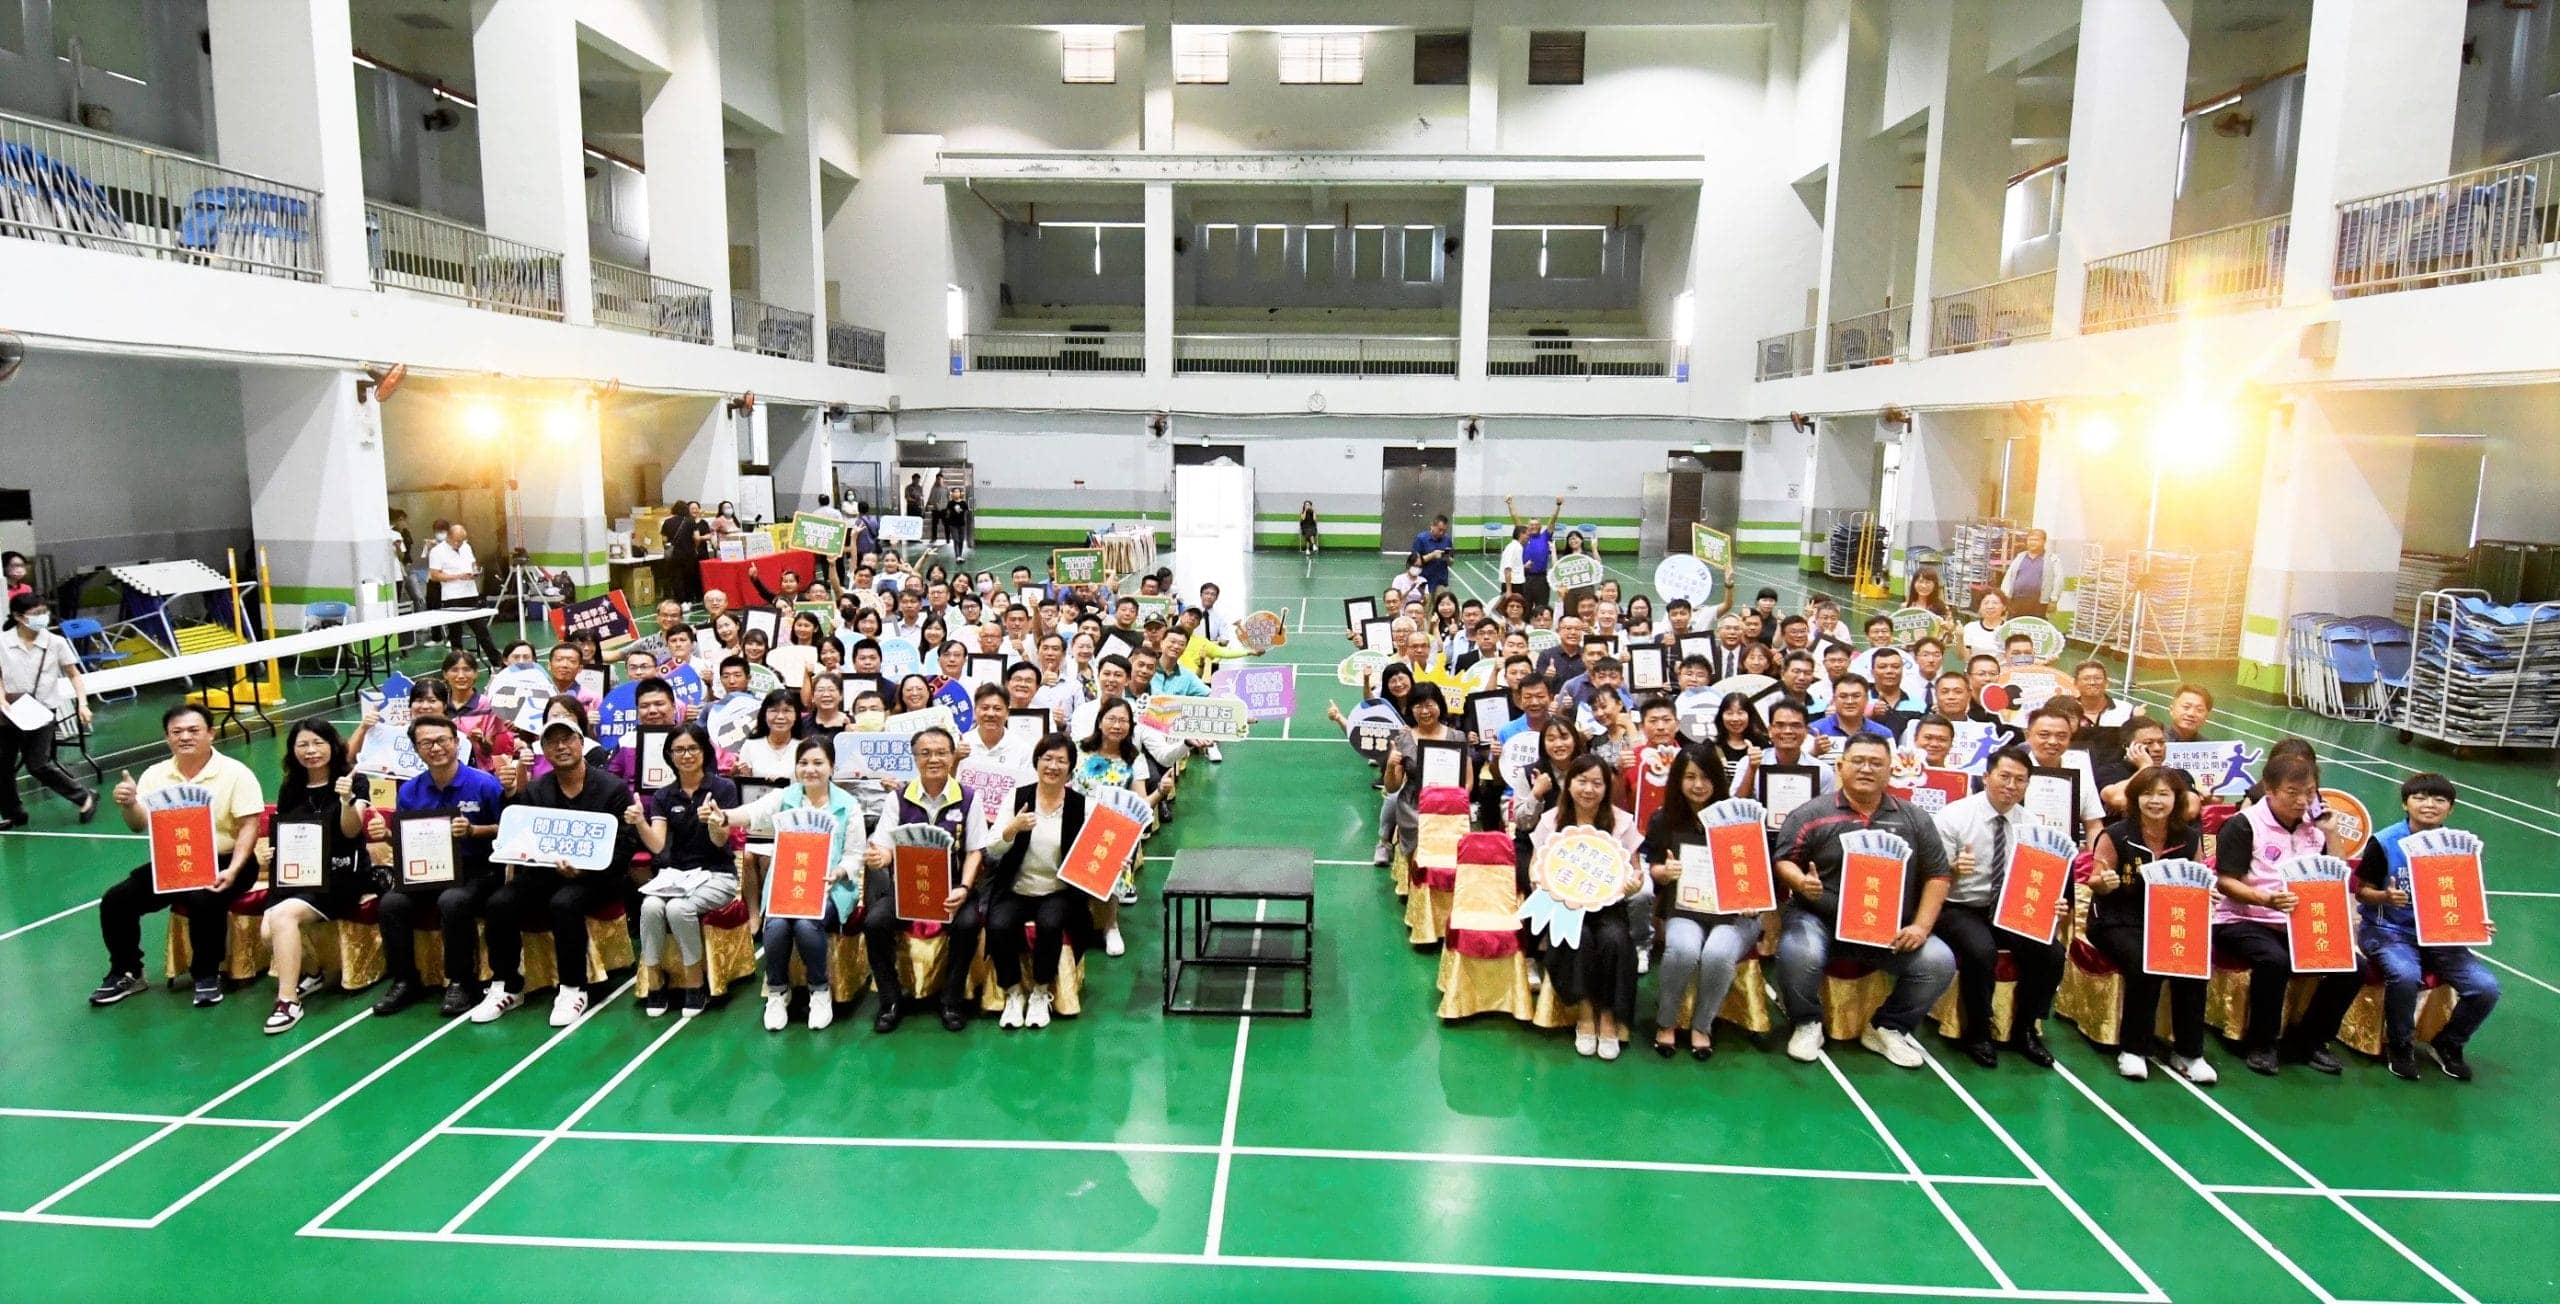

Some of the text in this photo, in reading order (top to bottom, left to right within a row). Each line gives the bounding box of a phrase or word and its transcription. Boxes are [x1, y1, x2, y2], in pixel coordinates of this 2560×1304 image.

[2172, 751, 2219, 760] 新北城市盃
[961, 769, 1016, 790] 全國學生
[533, 817, 606, 839] 閱讀磐石
[538, 836, 594, 858] 學校獎
